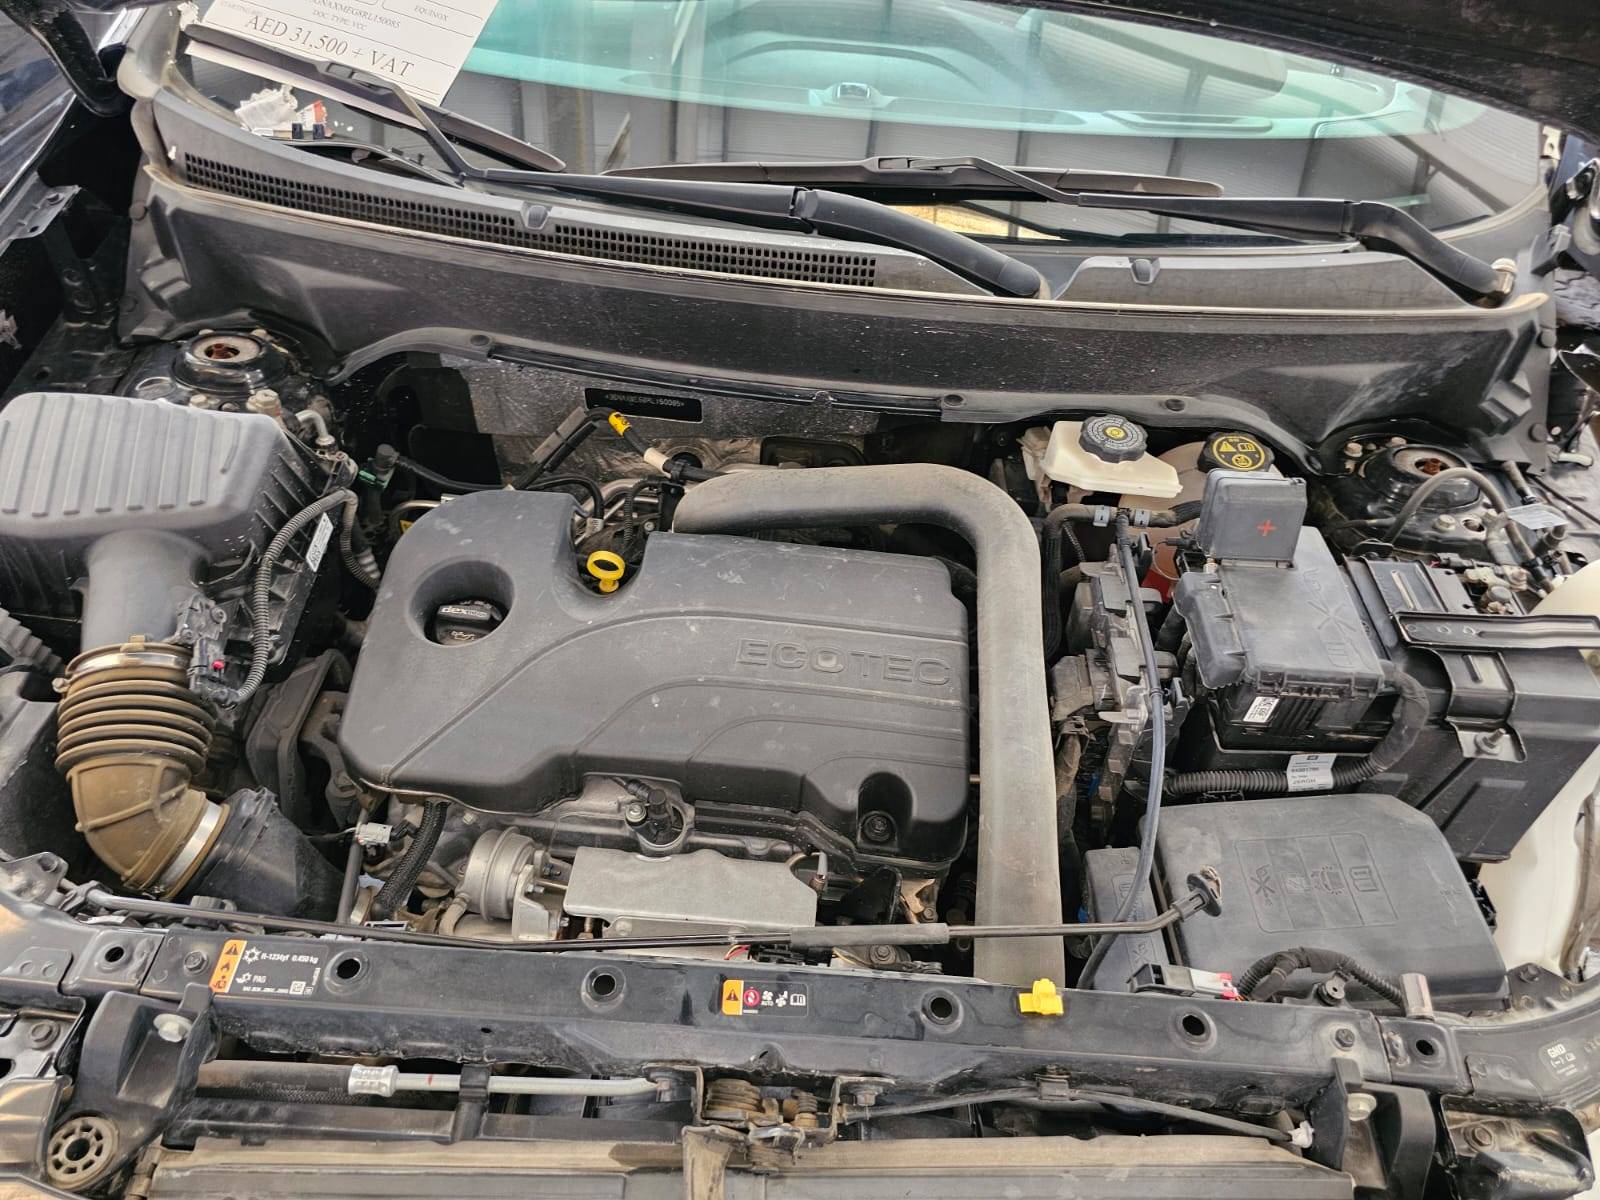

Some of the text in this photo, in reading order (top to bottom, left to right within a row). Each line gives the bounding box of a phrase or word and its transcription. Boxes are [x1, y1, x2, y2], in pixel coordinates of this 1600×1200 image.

[414, 5, 449, 21] EQUINOX
[245, 15, 415, 77] AED 31,500 + VAT
[732, 637, 951, 686] ECOTEC
